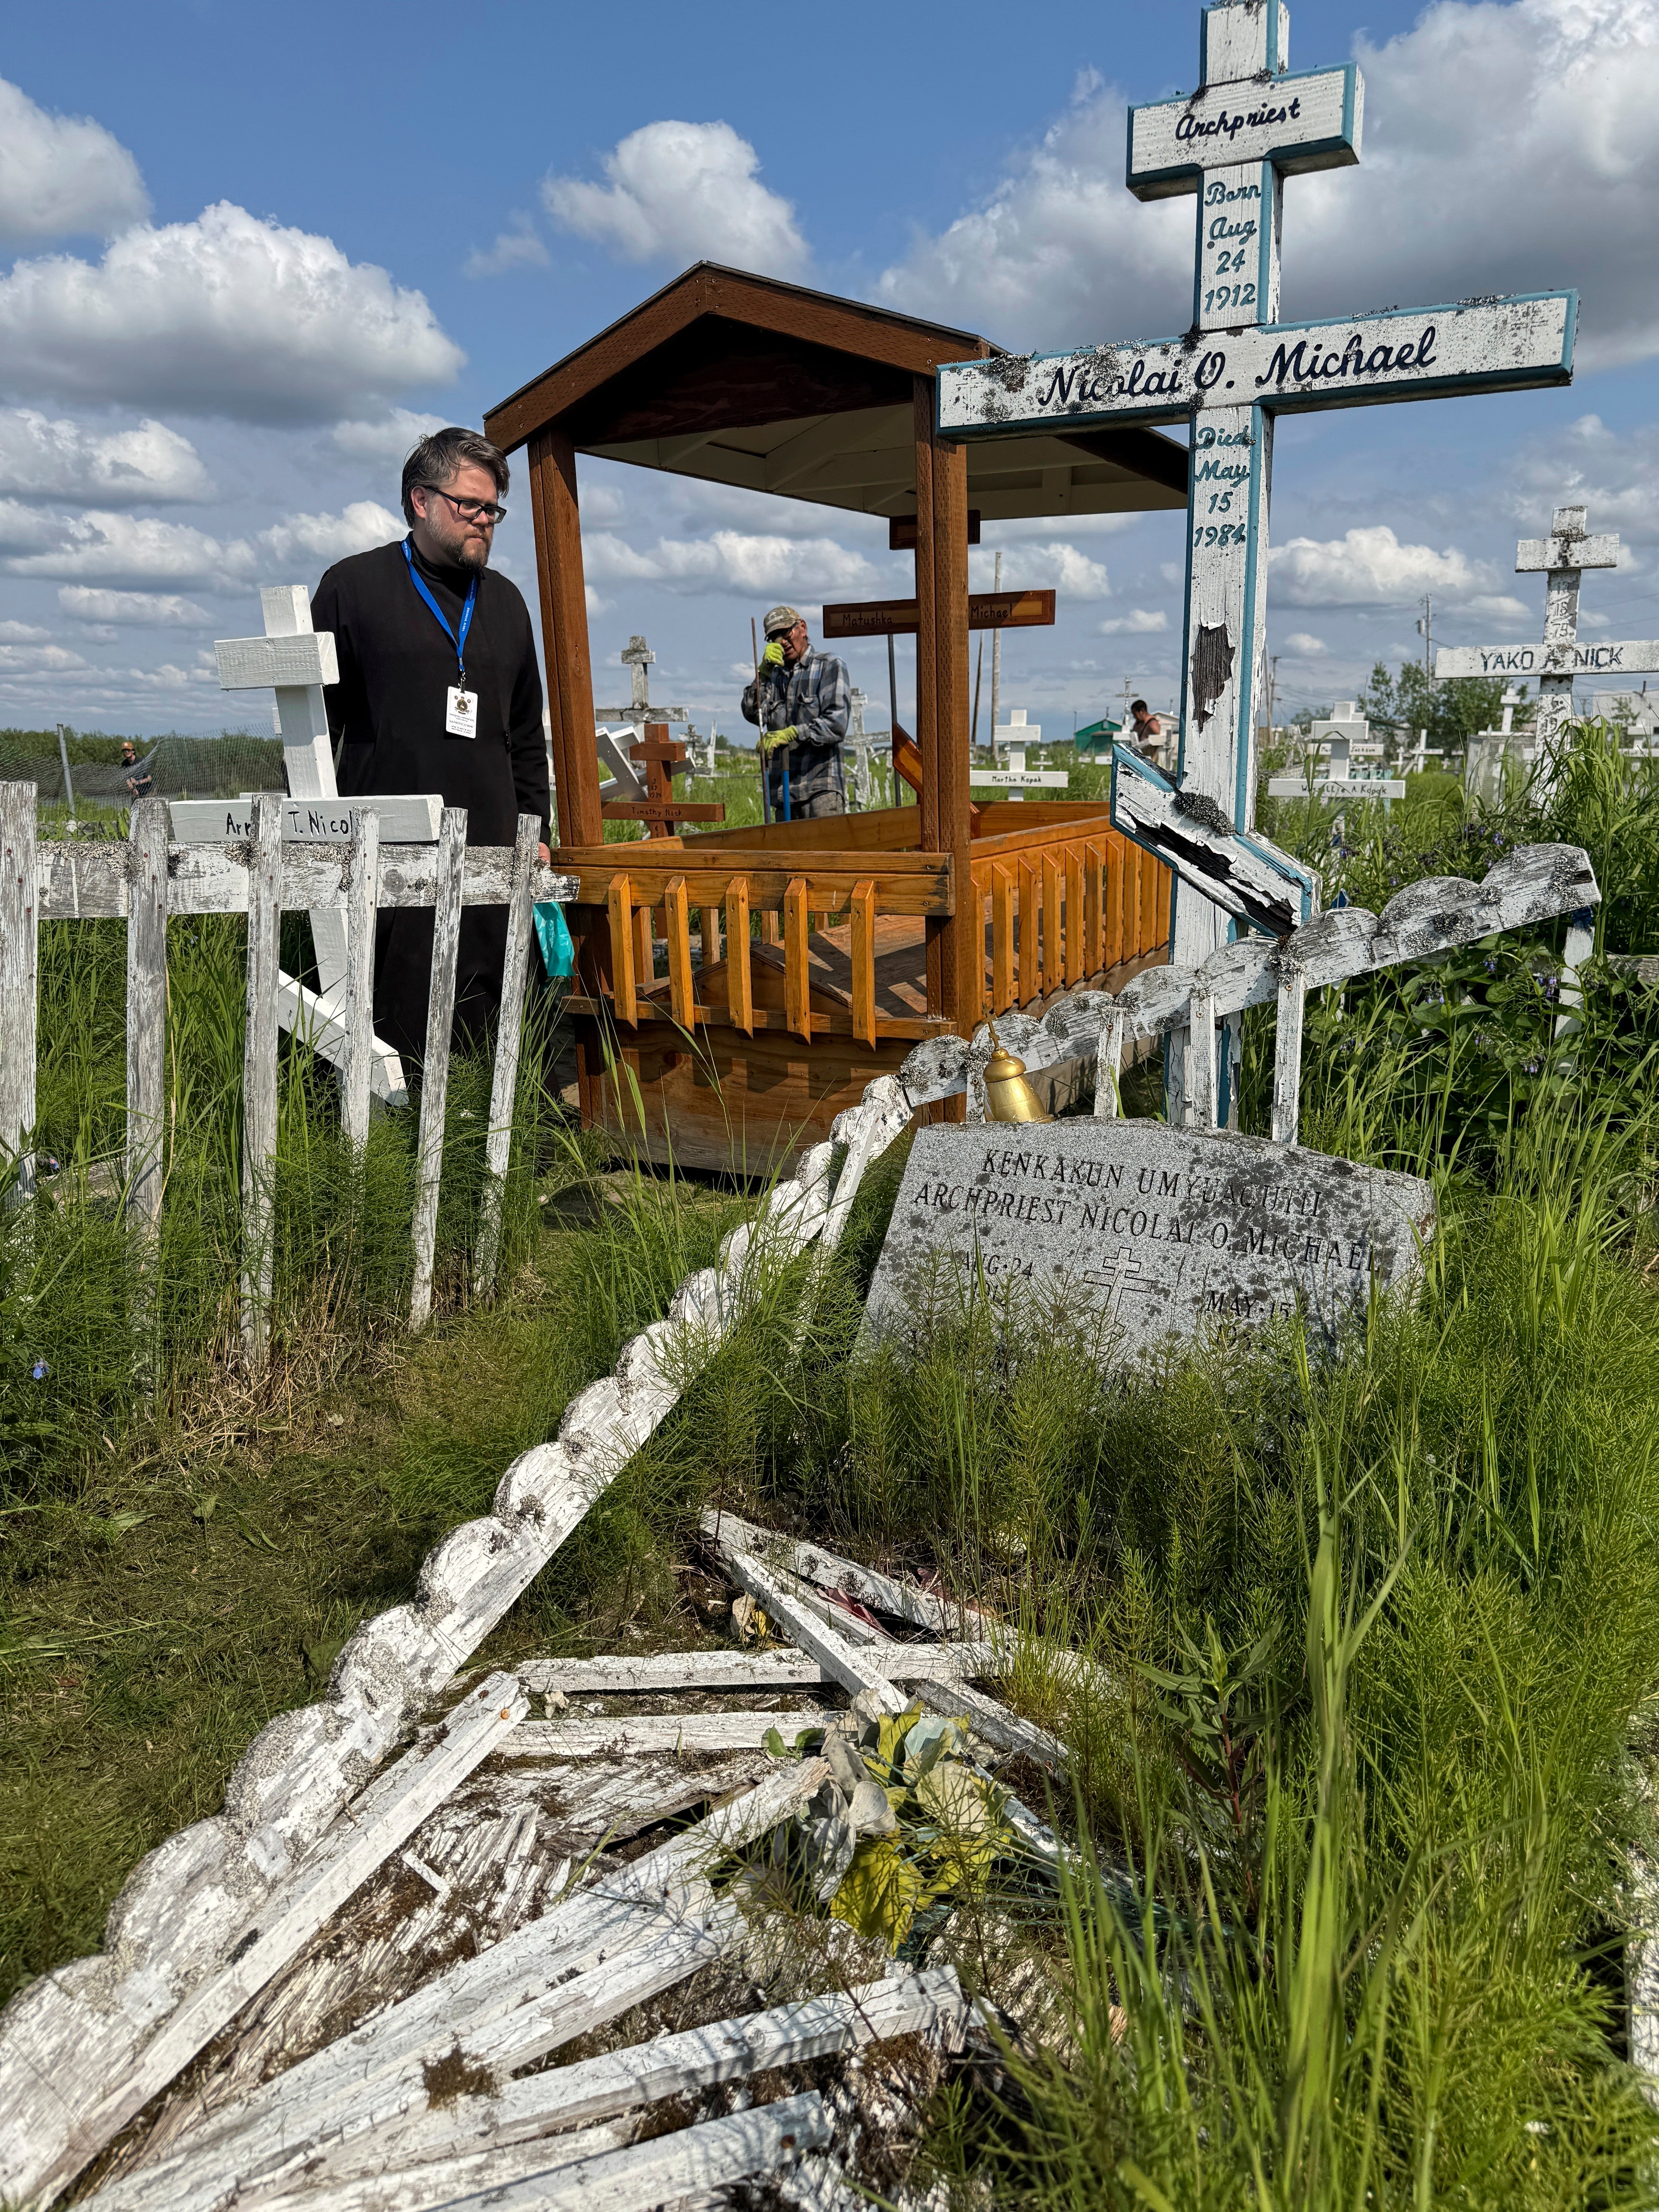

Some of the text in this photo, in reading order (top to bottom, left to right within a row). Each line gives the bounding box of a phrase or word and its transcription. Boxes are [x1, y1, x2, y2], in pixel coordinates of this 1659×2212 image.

[1175, 98, 1301, 141] Archpriest
[1204, 180, 1262, 207] Born
[1210, 217, 1257, 245] Aug
[1214, 249, 1245, 276] 24
[1204, 283, 1256, 313] 1912
[1038, 326, 1437, 406] Nicolai O. Michael
[1196, 425, 1250, 450] Died
[1194, 460, 1250, 488] May
[1208, 491, 1234, 514] 15
[1194, 523, 1246, 548] 1984
[843, 603, 1013, 626] Matushka Michael
[1480, 650, 1534, 672] YAKO
[1574, 647, 1624, 668] NICK
[288, 811, 304, 834] T.
[307, 809, 353, 838] Nicol
[631, 807, 661, 817] Timothy
[912, 1182, 1072, 1224] ARCHPRIEST
[1080, 1203, 1195, 1244] NICOLAI
[1243, 1227, 1380, 1273] MICHAEL
